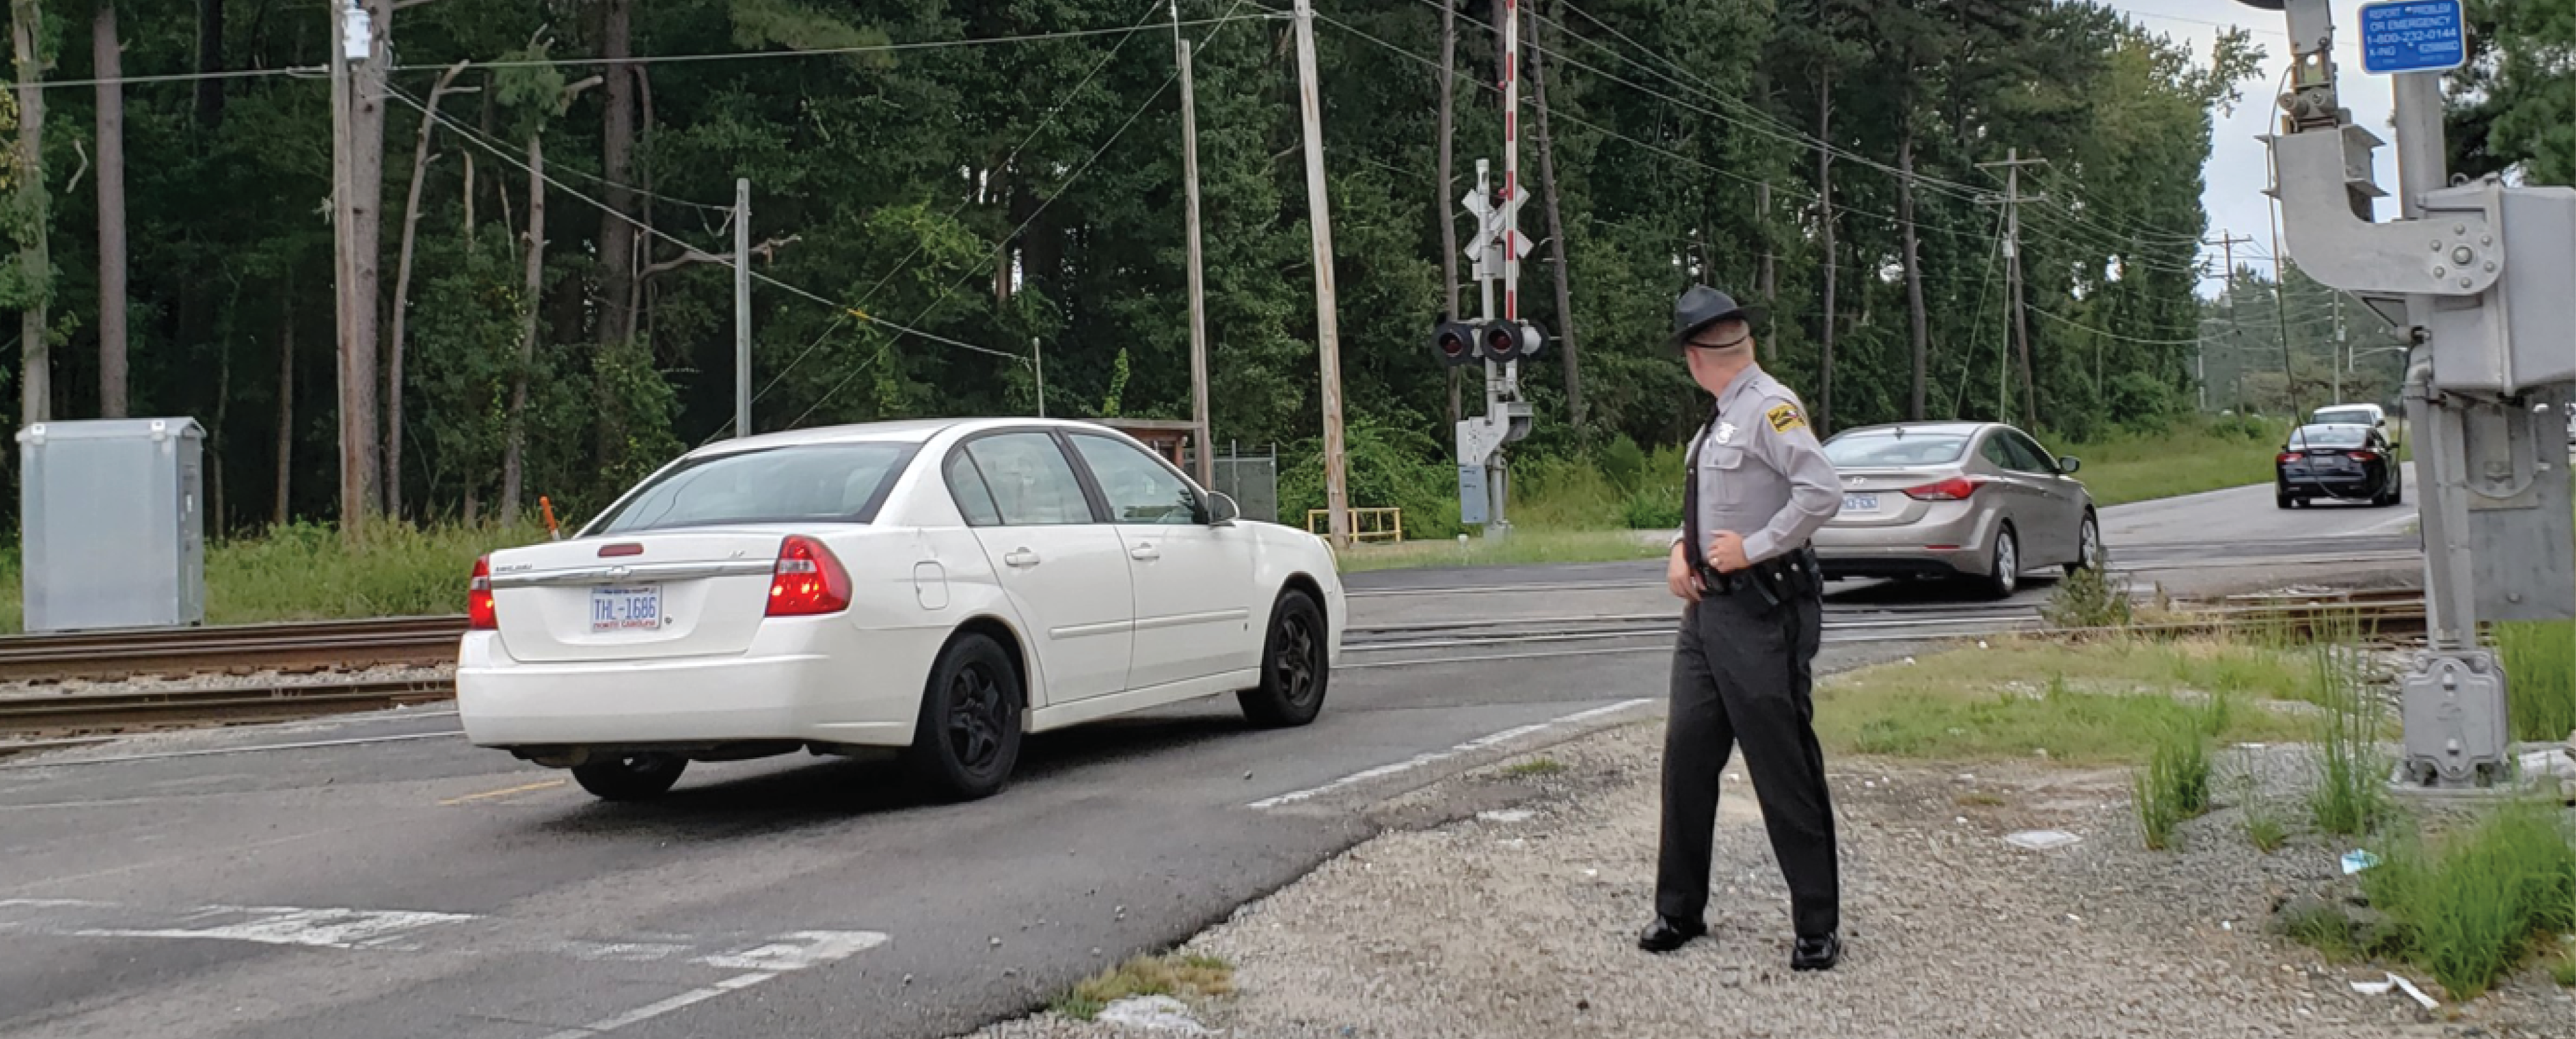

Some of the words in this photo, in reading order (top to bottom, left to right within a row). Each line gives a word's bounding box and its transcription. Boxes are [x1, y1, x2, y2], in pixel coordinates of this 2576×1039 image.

[2369, 8, 2400, 18] REPORT
[2369, 22, 2385, 31] OR
[2389, 16, 2450, 29] EMERGENCY
